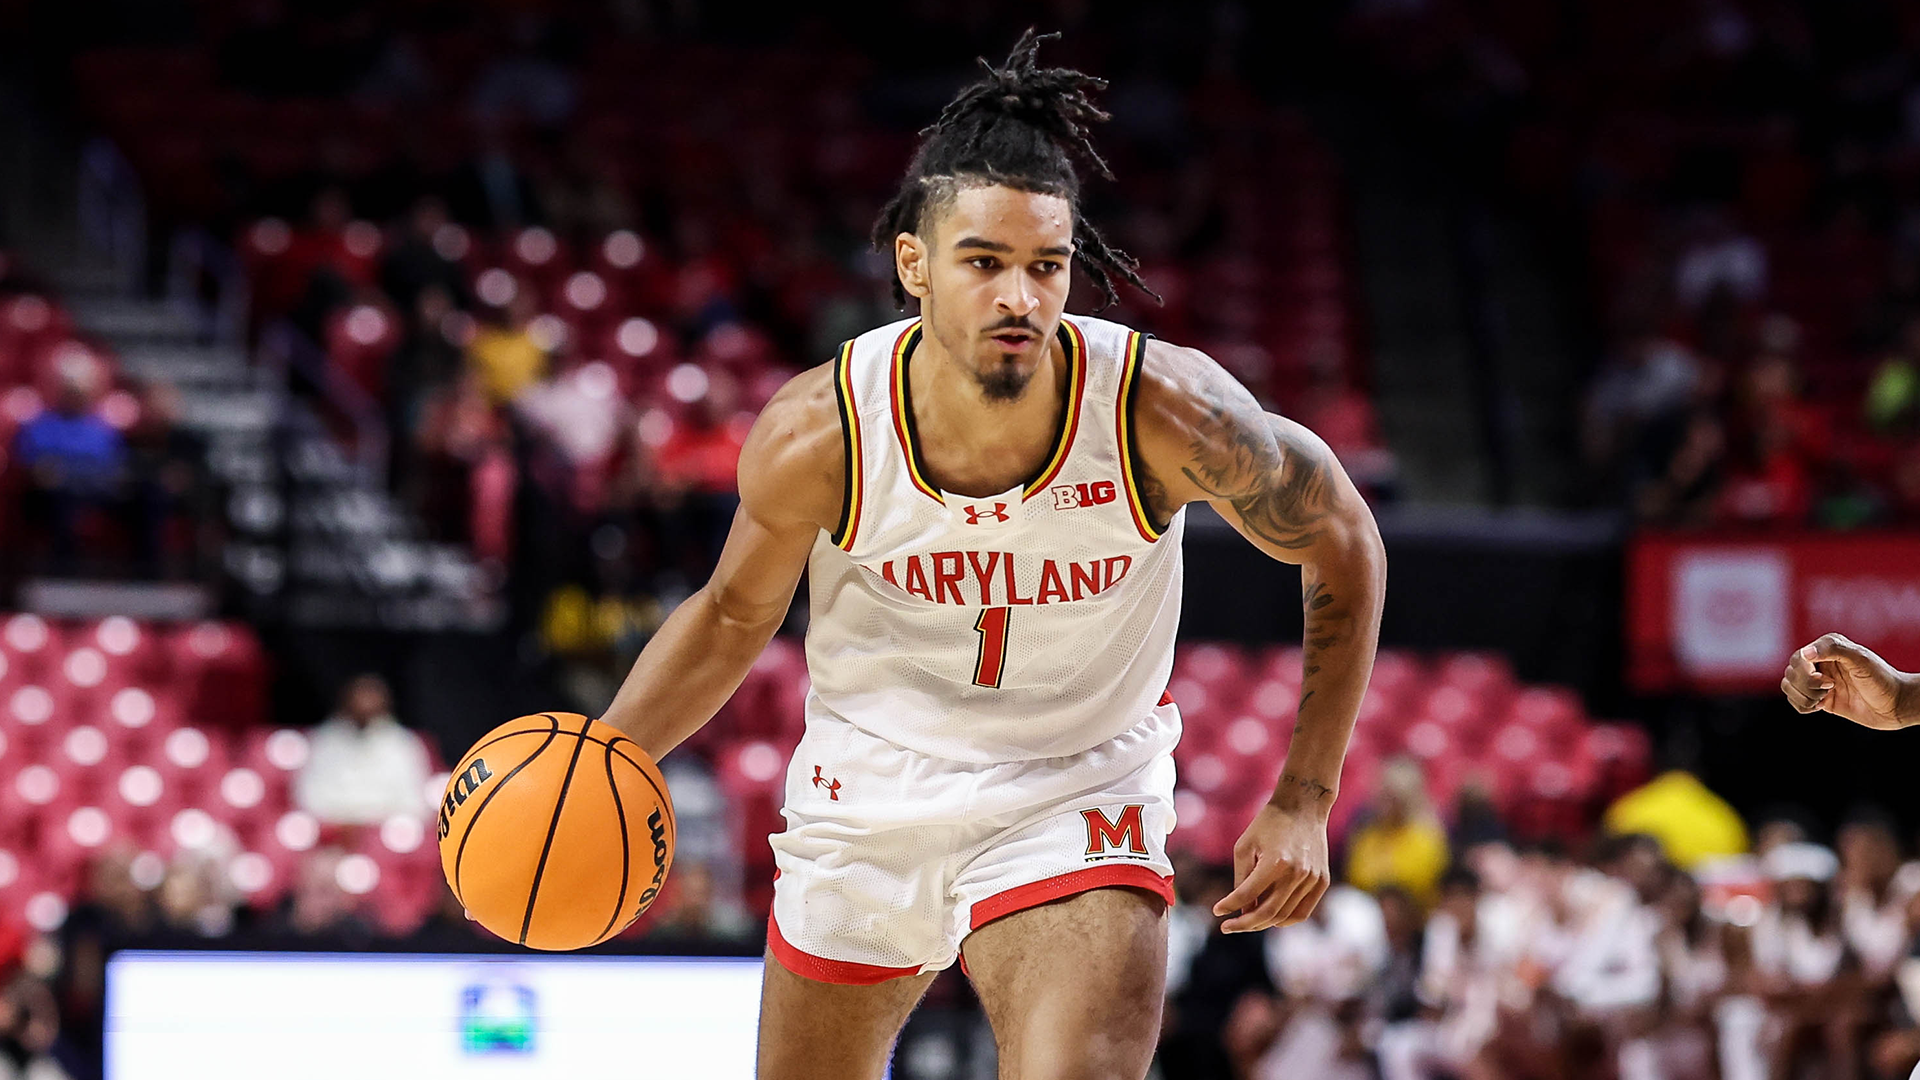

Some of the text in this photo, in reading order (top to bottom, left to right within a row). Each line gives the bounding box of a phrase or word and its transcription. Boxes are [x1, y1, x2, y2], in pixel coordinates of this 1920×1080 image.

[972, 606, 1011, 689] 1
[624, 806, 667, 927] lson
[1080, 805, 1149, 855] M
